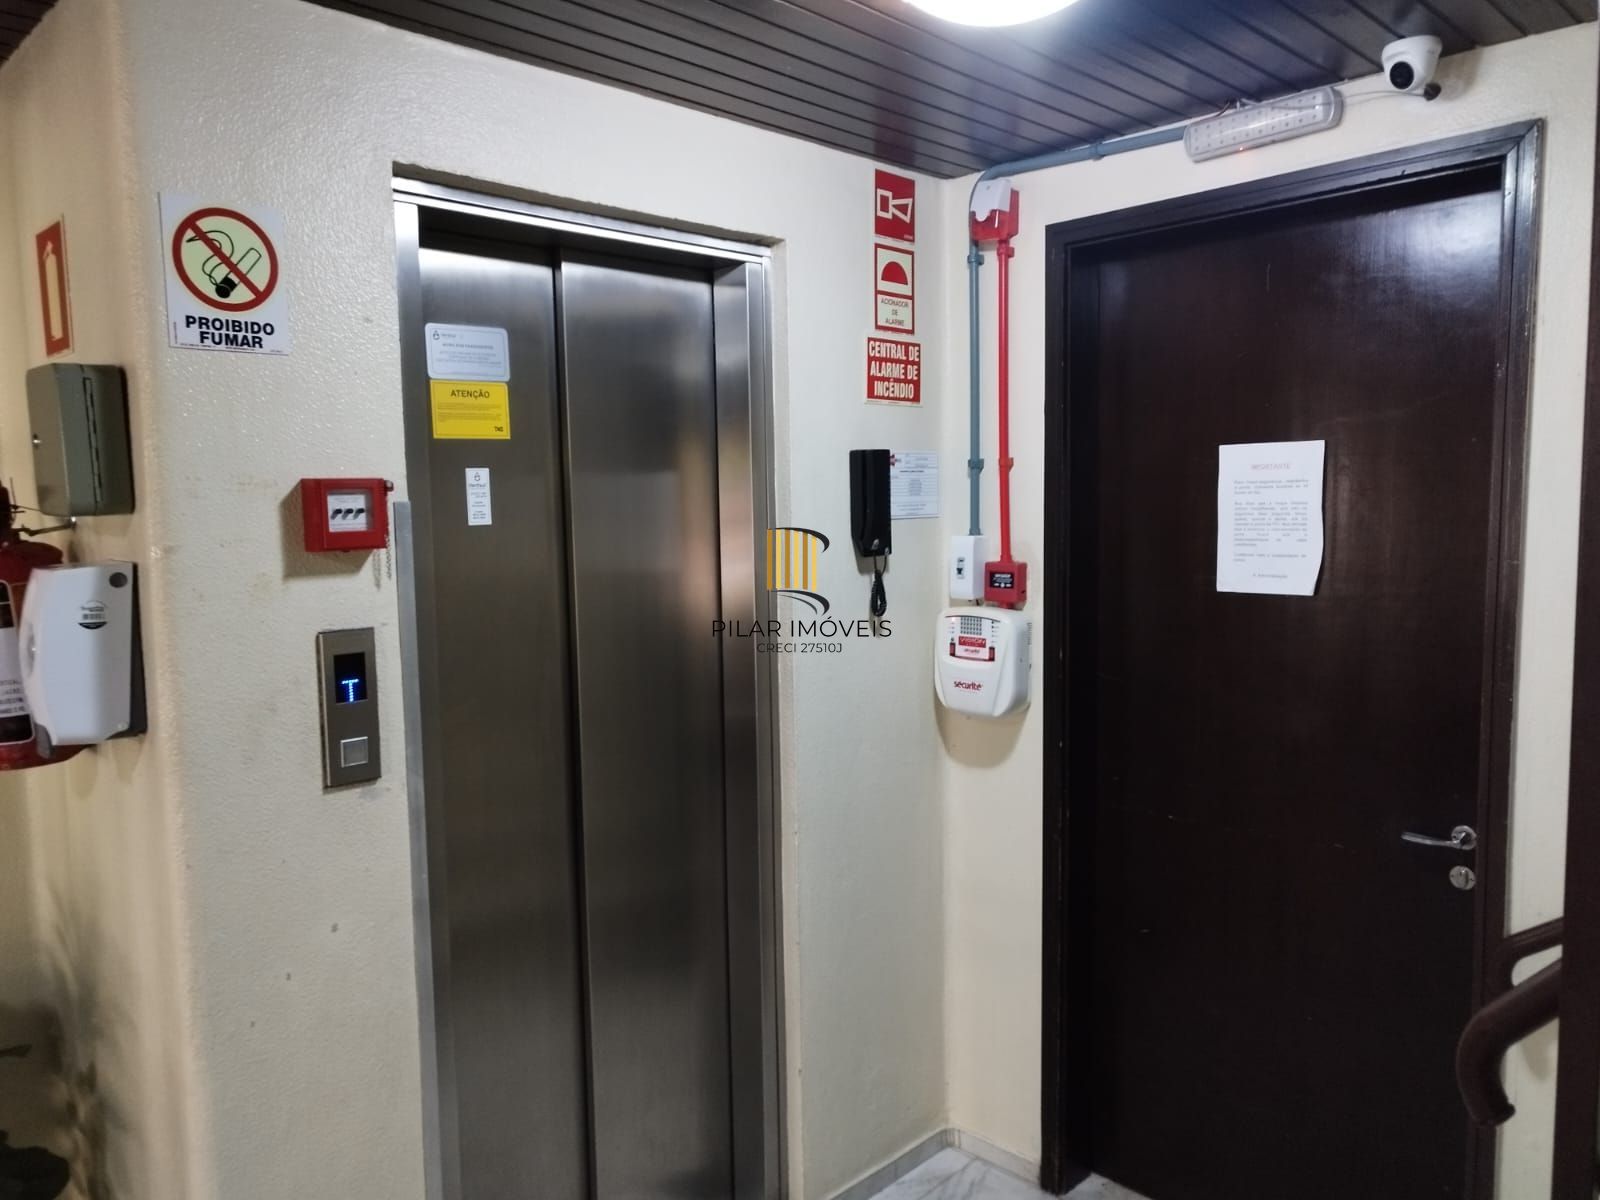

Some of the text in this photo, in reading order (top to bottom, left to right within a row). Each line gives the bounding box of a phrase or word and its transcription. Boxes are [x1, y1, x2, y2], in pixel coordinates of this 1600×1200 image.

[185, 315, 275, 336] PROIBIDO
[199, 331, 263, 349] FUMAR
[869, 341, 920, 362] CENTRAL DE
[870, 360, 918, 380] ALARME DE
[450, 388, 490, 400] ATENÇÃO
[874, 378, 914, 399] INCÊNDIO
[341, 678, 359, 702] T
